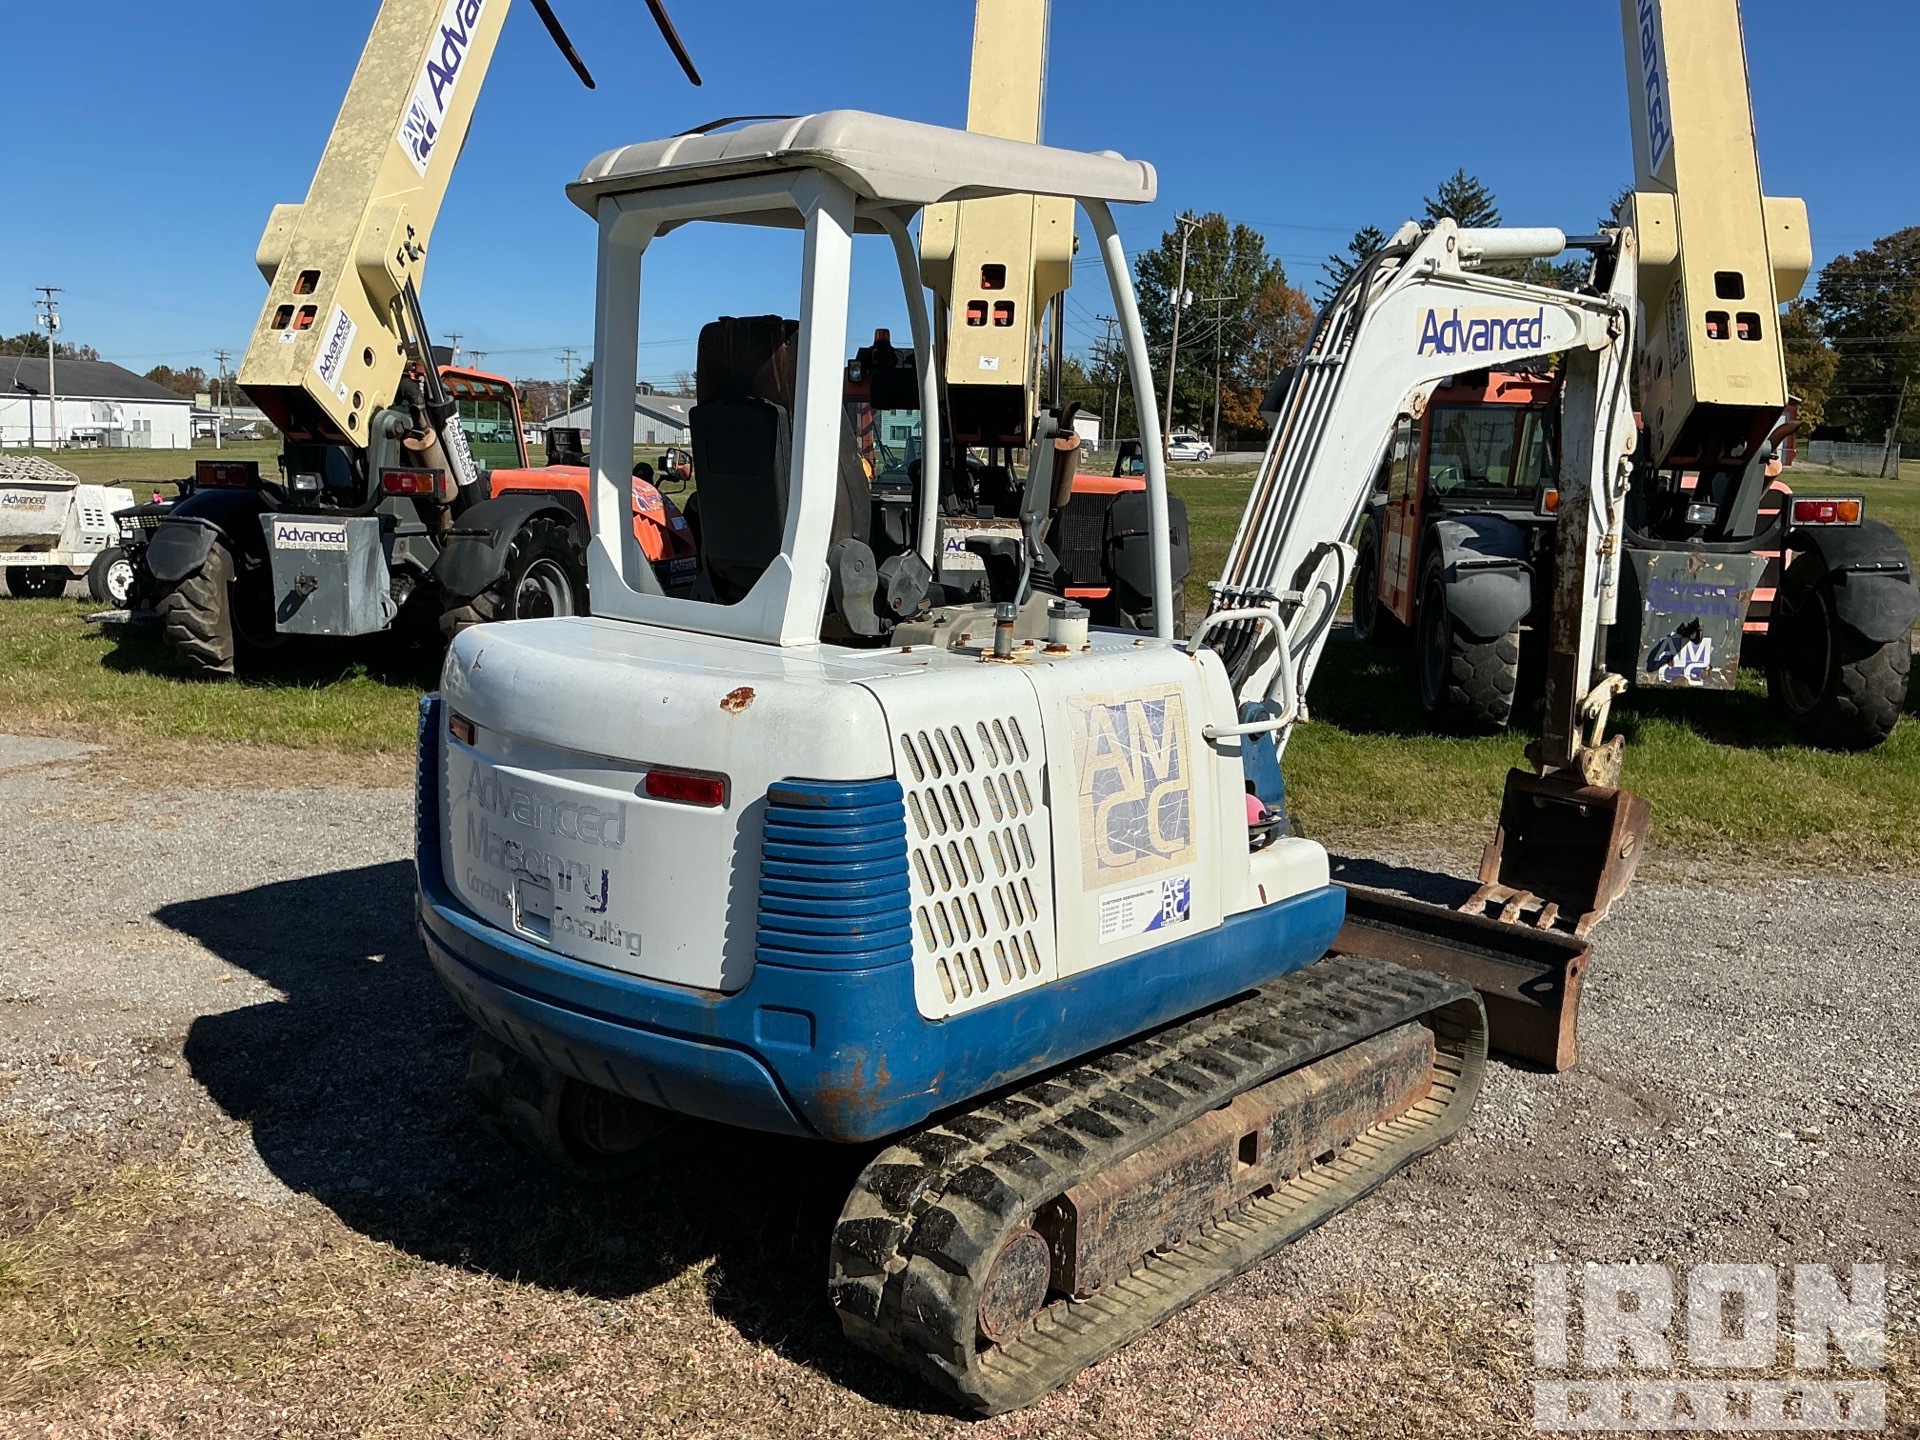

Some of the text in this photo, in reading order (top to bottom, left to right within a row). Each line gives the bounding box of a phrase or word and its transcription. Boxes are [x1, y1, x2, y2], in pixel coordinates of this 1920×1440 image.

[1637, 0, 1670, 169] vanced
[319, 309, 349, 380] Advanced
[1417, 306, 1544, 355] Advanced
[2, 494, 47, 505] Advanced
[277, 527, 345, 543] Advanced
[466, 760, 627, 850] Advanced
[467, 811, 610, 914] Masonry
[553, 907, 642, 957] Consulting
